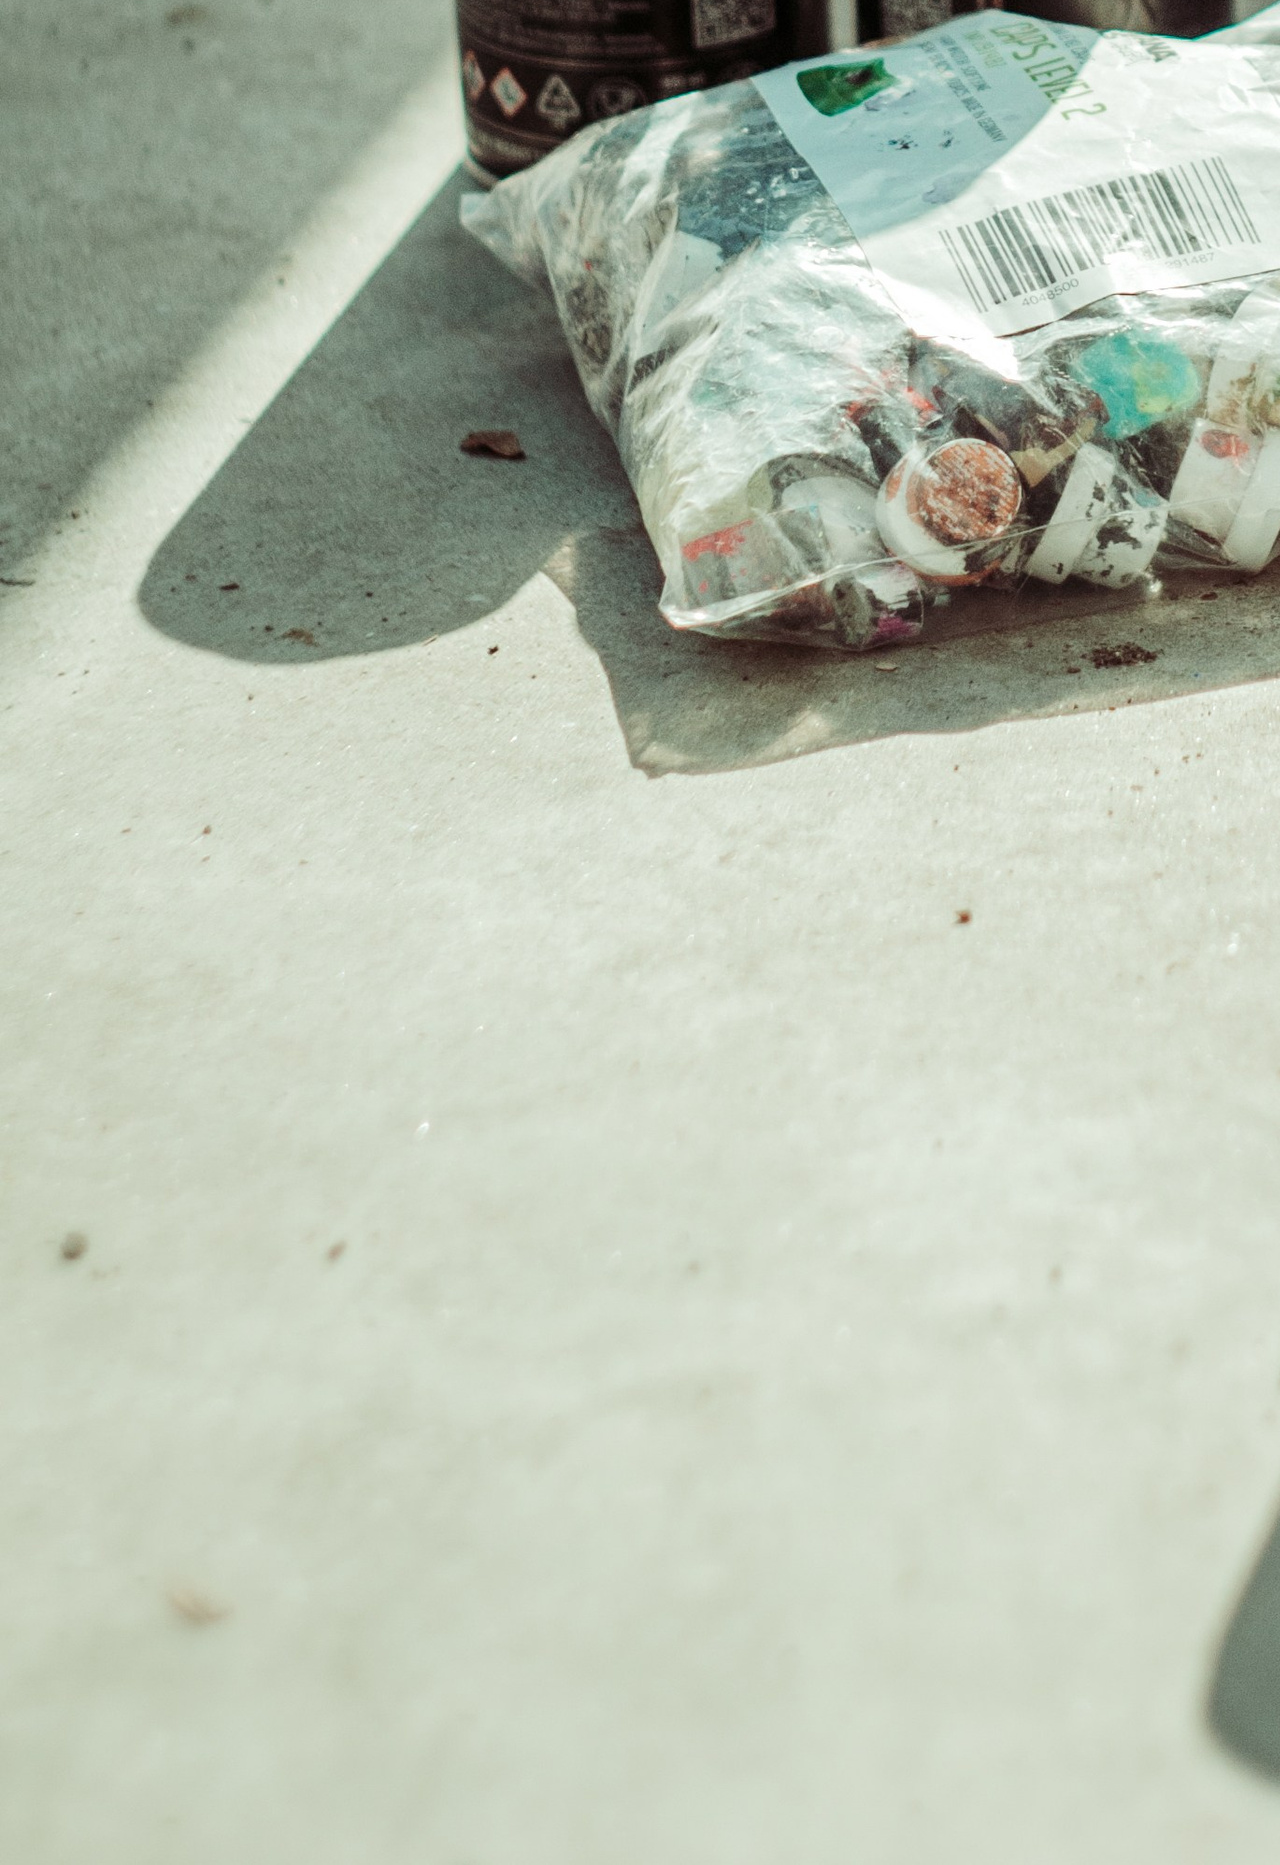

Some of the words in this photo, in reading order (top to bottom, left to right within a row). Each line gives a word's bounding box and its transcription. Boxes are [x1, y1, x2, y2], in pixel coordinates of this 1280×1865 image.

[989, 22, 1057, 61] CAPS
[1024, 56, 1094, 104] LEVEL
[1061, 101, 1107, 121] 2
[1021, 277, 1080, 308] 4048500
[1164, 251, 1216, 270] 291487
